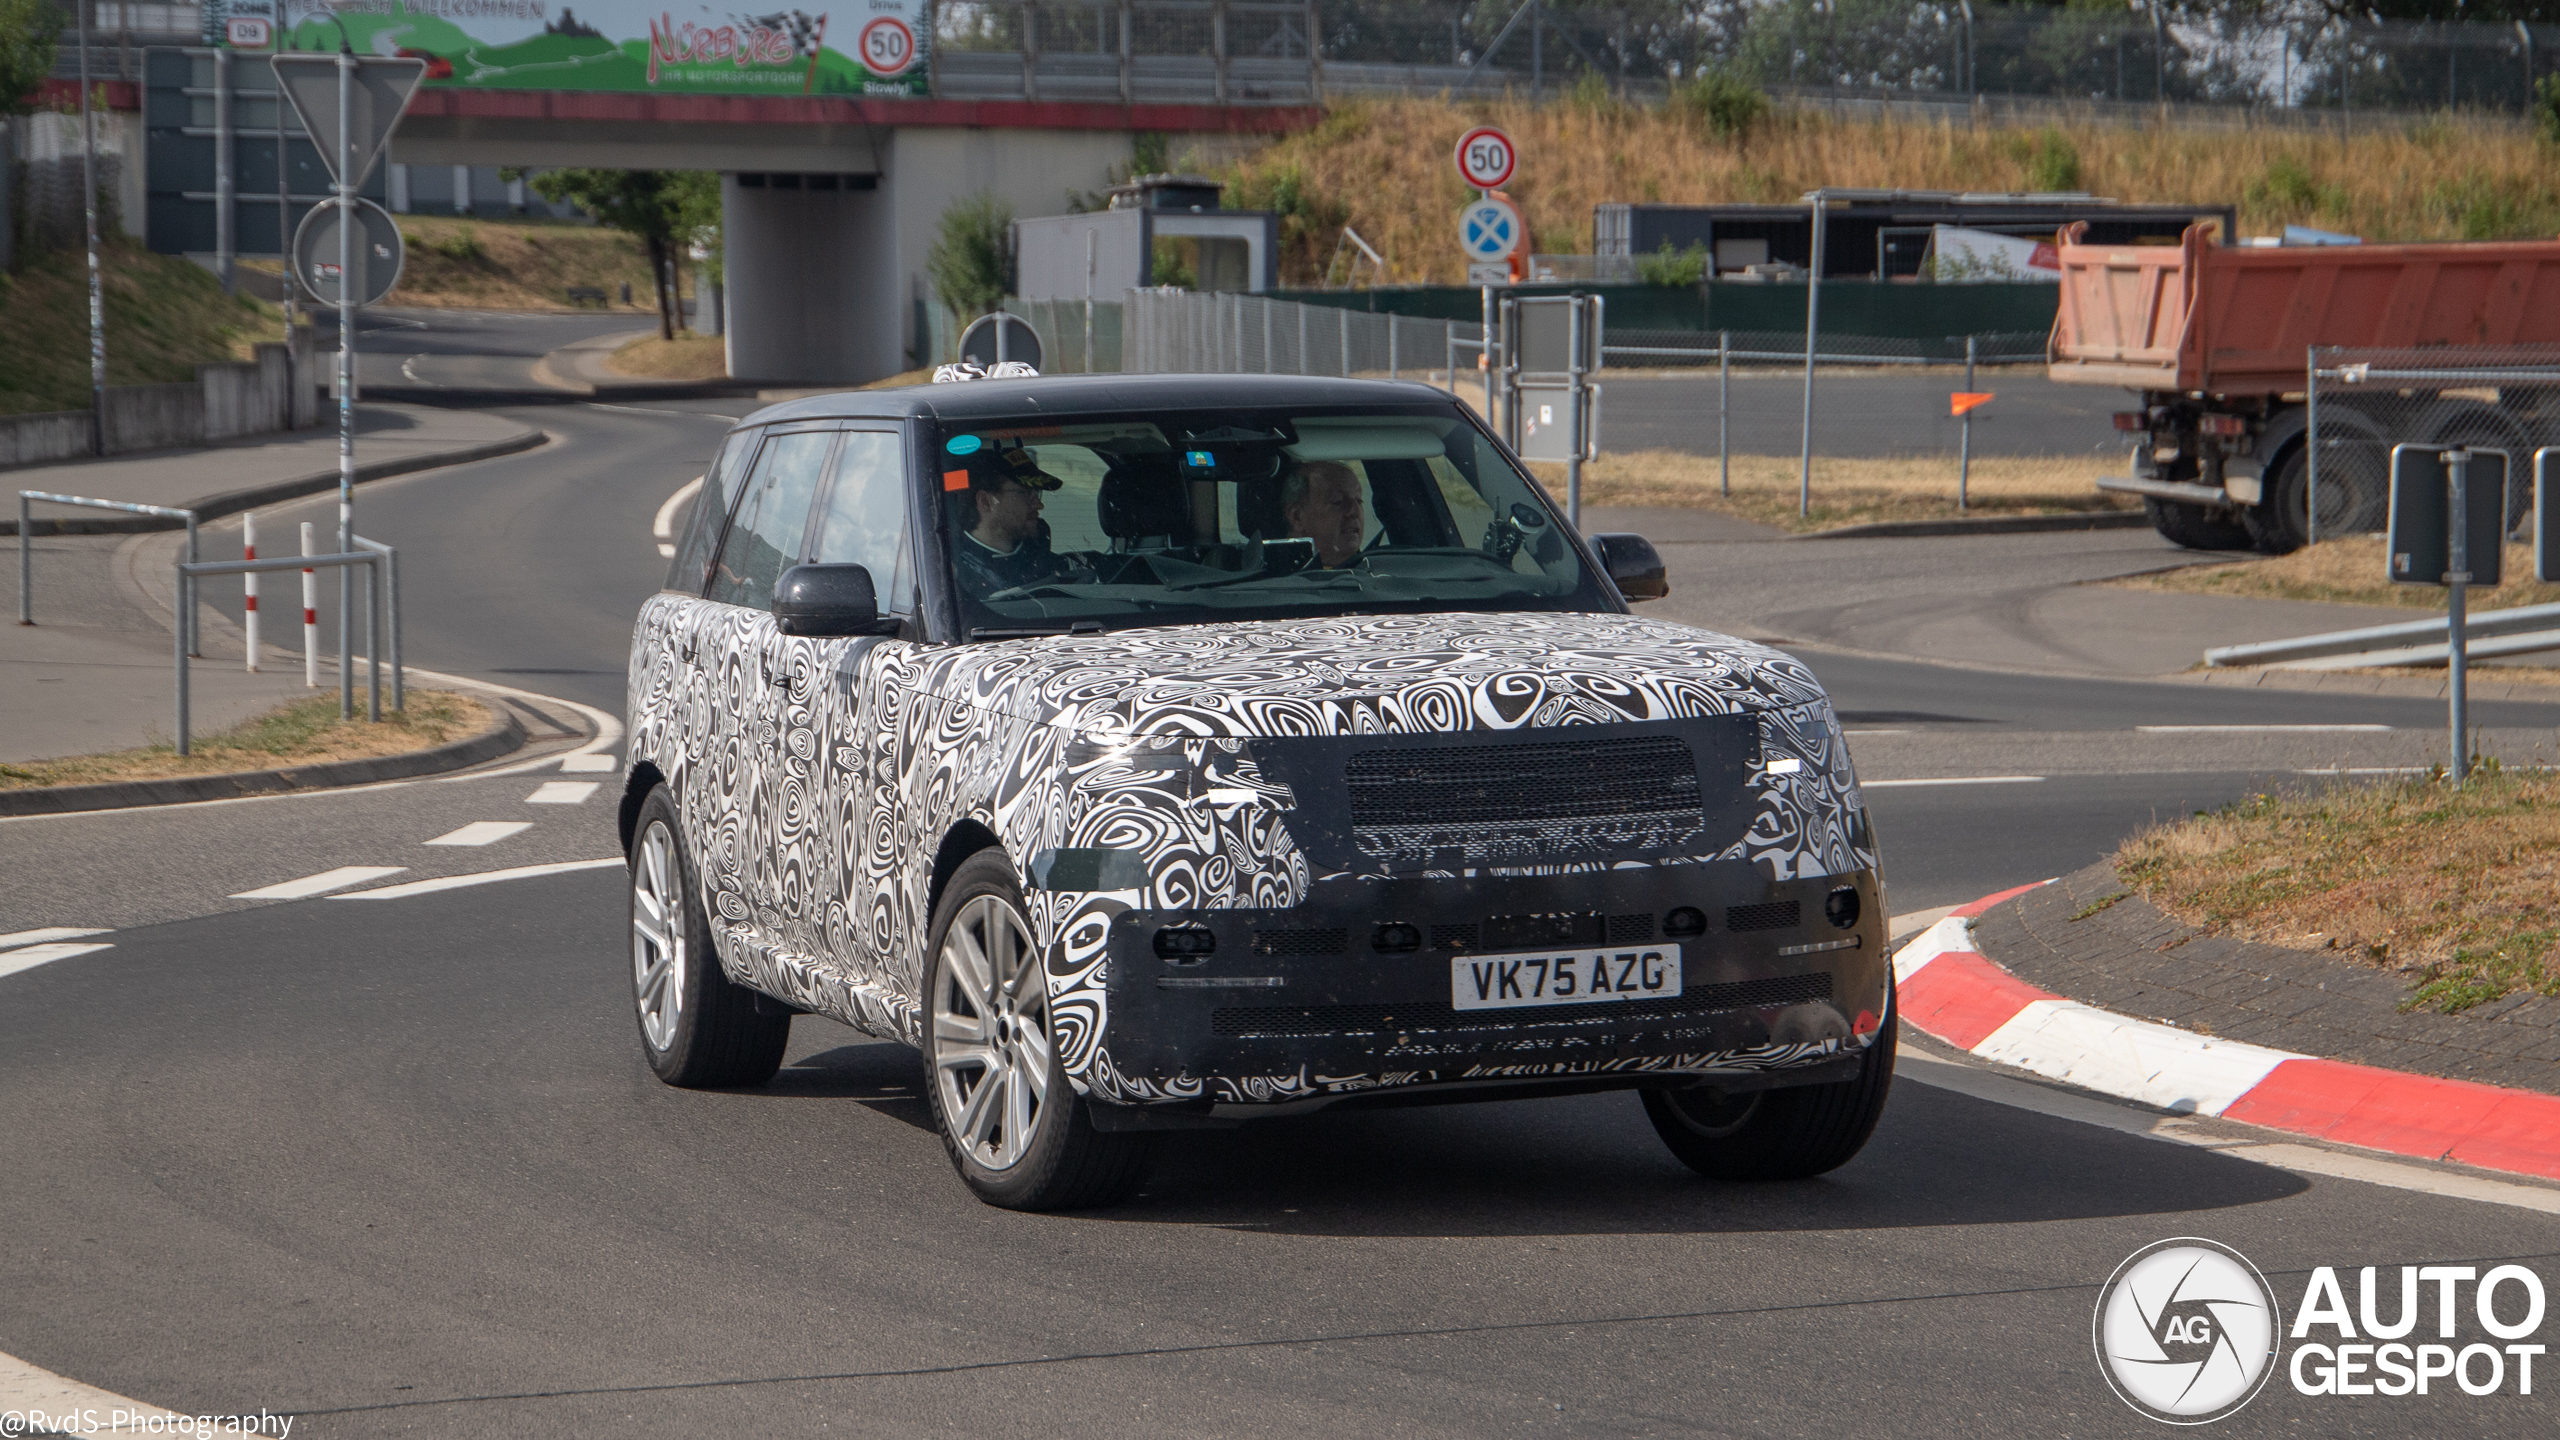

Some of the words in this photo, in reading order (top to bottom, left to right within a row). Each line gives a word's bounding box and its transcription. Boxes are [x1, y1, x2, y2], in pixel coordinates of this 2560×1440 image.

[403, 0, 545, 18] WILLKOMMEN
[647, 11, 794, 84] NÜRBURG
[871, 31, 903, 57] 50
[1471, 144, 1504, 172] 50
[1471, 957, 1577, 1001] VK75
[1590, 951, 1664, 994] AZG
